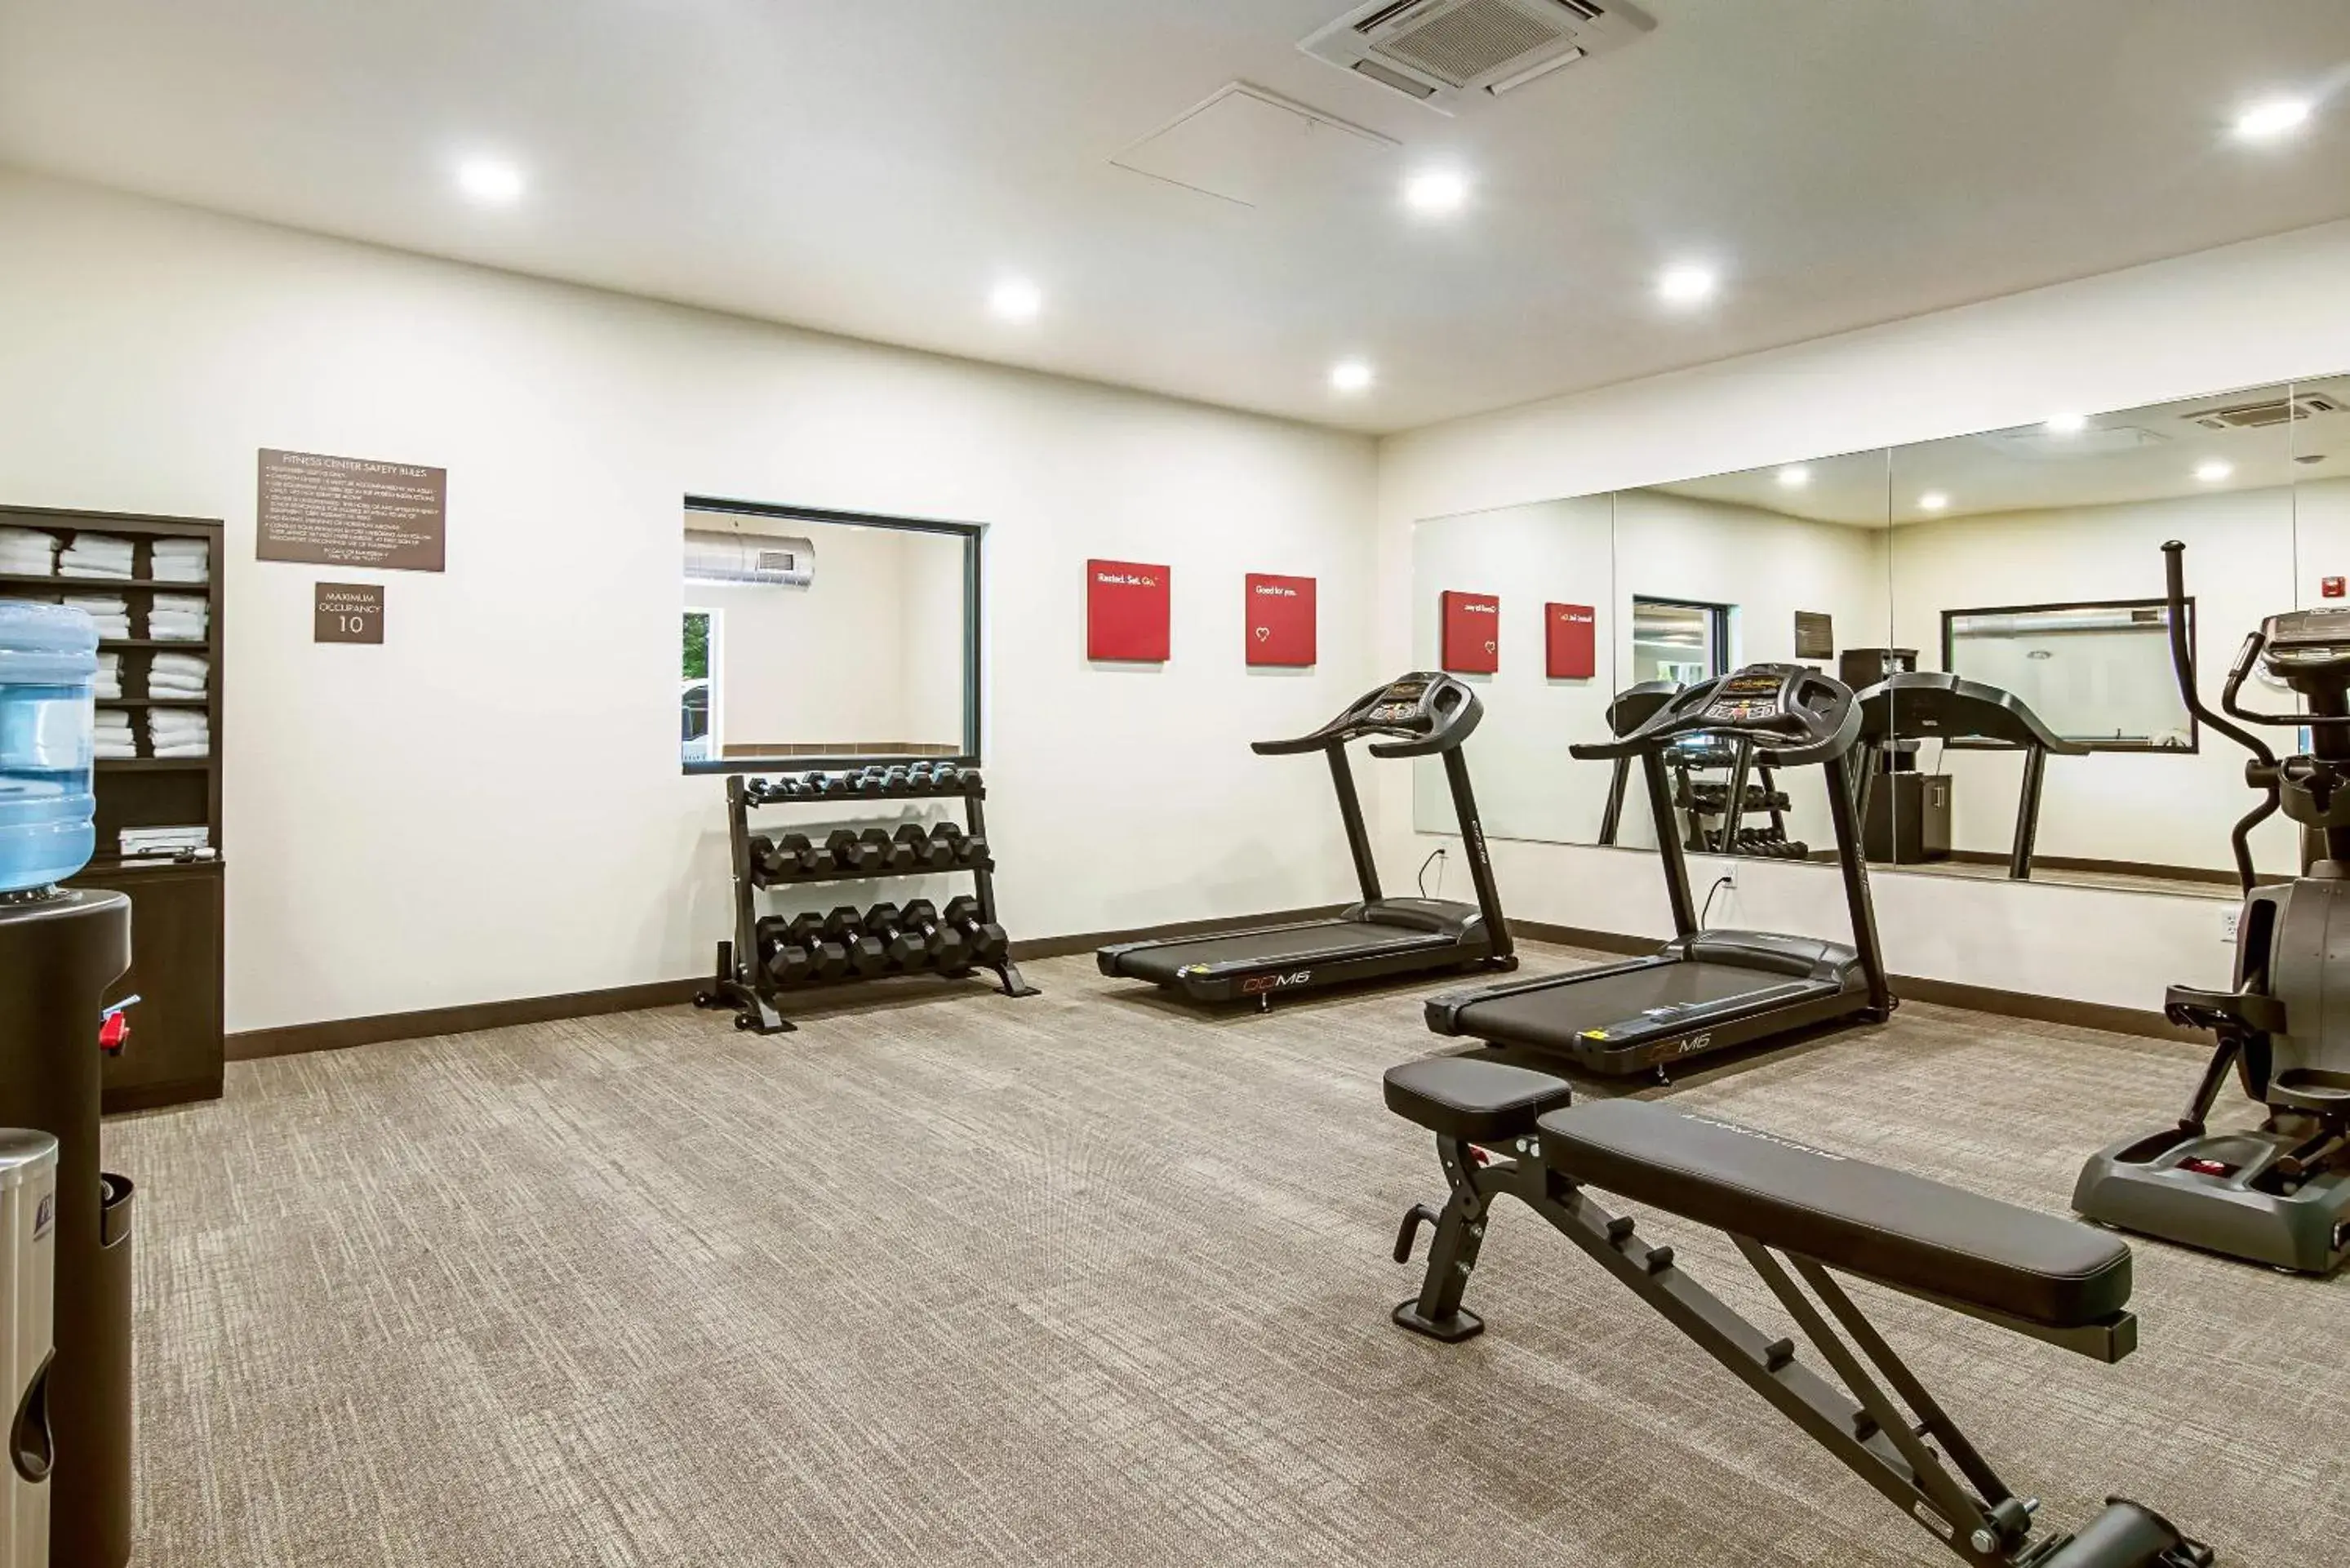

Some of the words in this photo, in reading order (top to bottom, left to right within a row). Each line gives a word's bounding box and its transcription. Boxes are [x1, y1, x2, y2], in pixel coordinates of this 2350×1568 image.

[282, 454, 322, 466] FITNESS
[364, 463, 398, 473] SAFETY
[1255, 585, 1274, 595] Good
[1275, 586, 1283, 594] for
[326, 592, 375, 602] MAXIMUM
[319, 602, 382, 613] OCCUPANCY
[339, 615, 363, 633] 10
